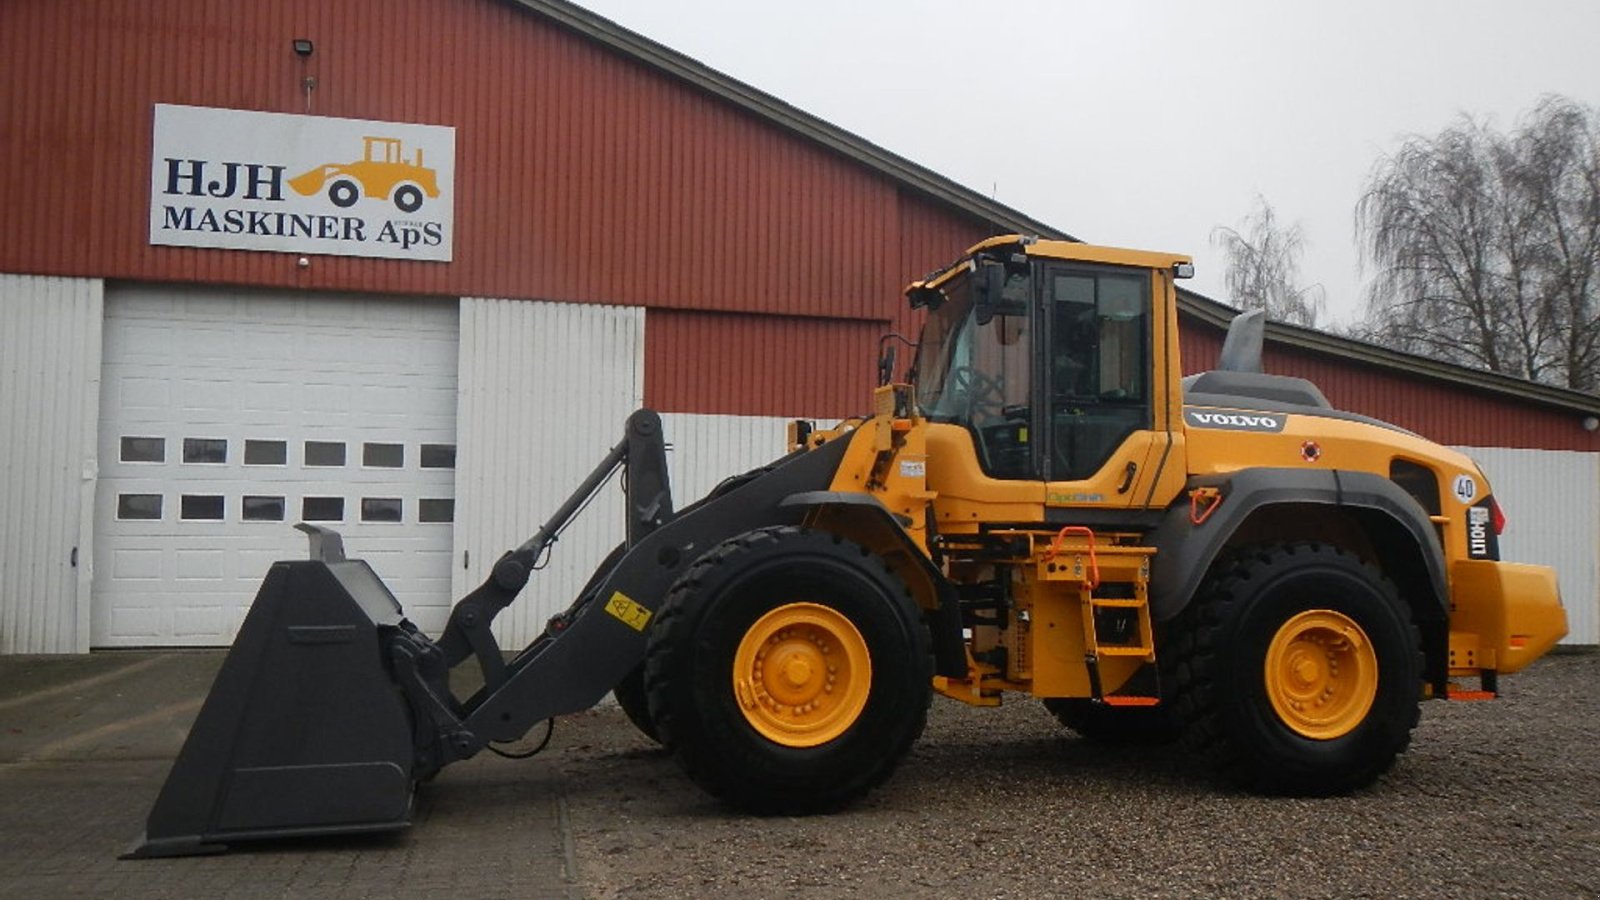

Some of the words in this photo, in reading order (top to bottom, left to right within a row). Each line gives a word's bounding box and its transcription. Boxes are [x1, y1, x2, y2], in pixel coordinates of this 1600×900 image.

[163, 158, 287, 201] HJH
[162, 205, 367, 242] MASKINER
[376, 220, 442, 249] ApS
[1191, 412, 1278, 428] VOLVO
[1457, 479, 1474, 498] 40
